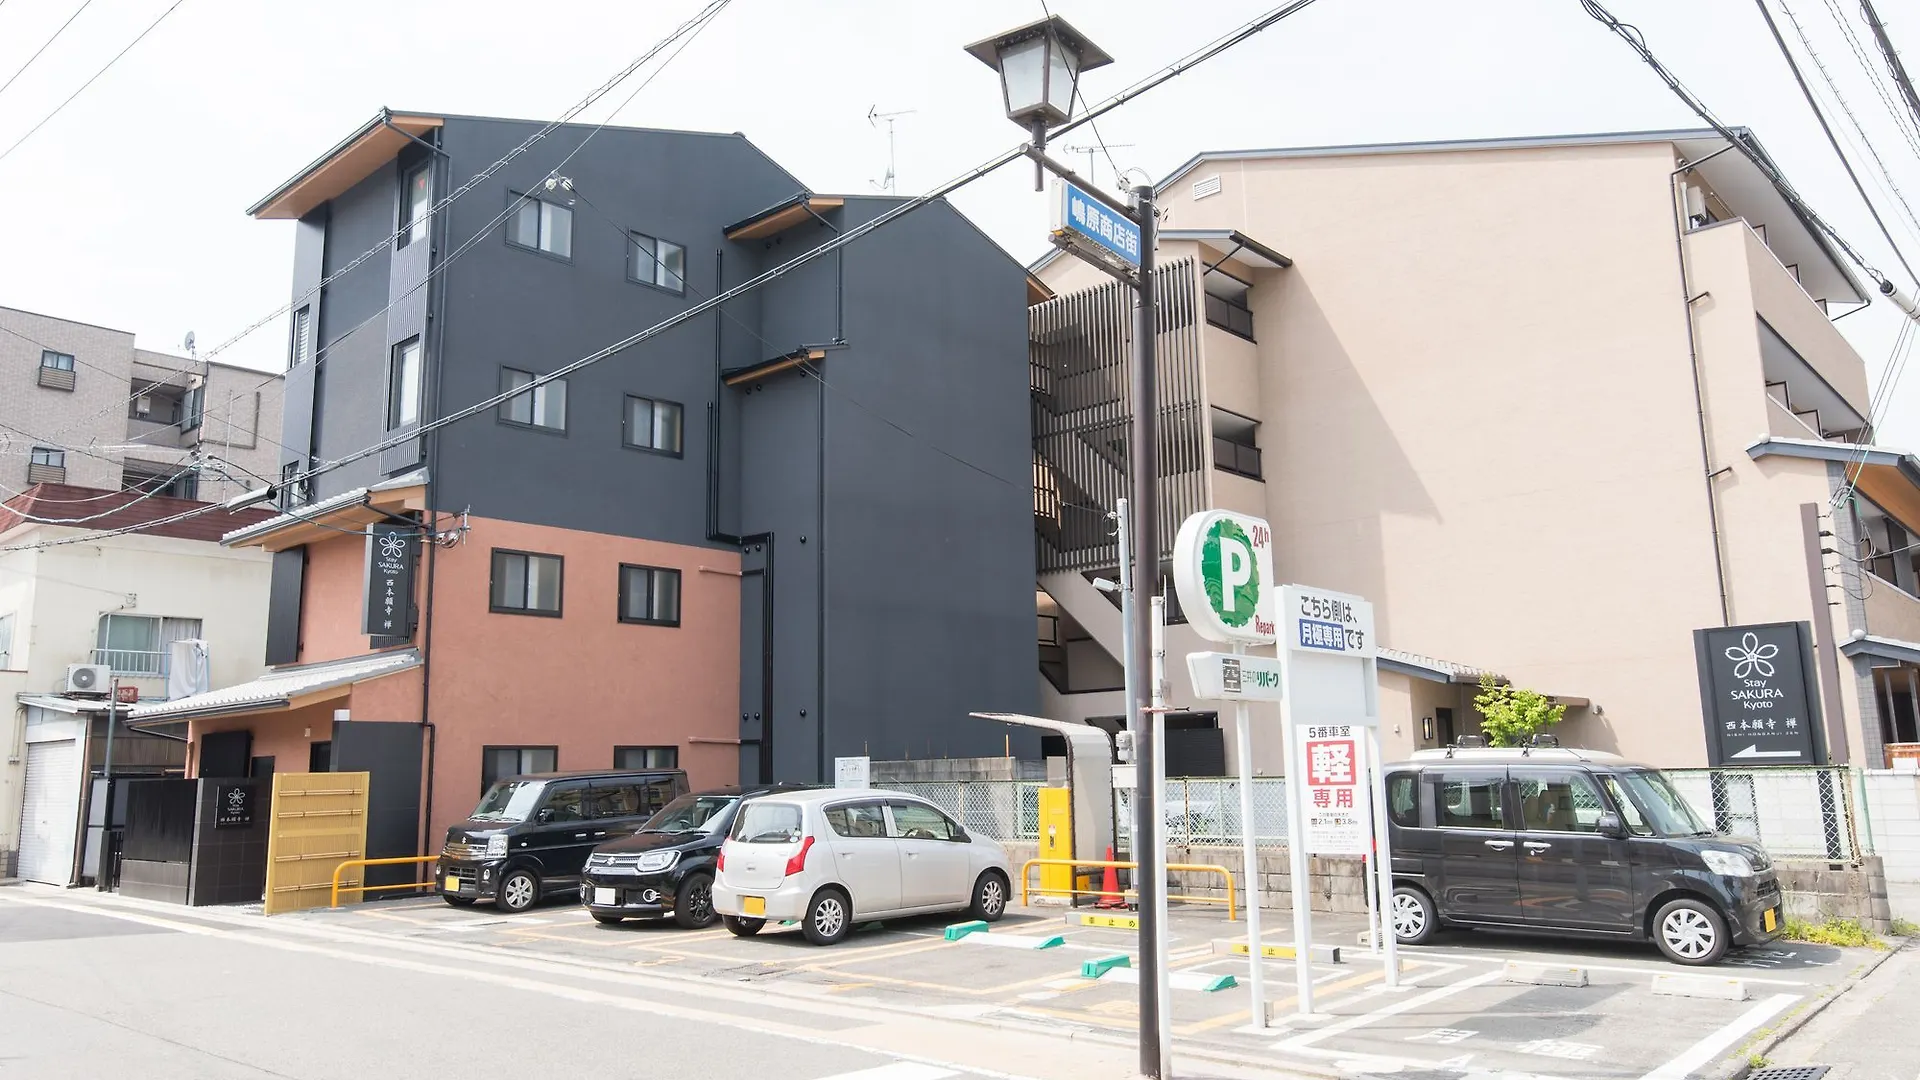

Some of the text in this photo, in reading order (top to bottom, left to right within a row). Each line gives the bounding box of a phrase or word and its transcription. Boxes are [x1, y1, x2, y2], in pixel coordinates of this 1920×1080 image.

[1253, 525, 1270, 548] 24h
[378, 562, 404, 570] SAKURA
[1219, 536, 1252, 612] P
[1301, 596, 1357, 623] こちら側は、
[1255, 615, 1276, 636] Repark
[1743, 679, 1767, 688] Stay
[1730, 689, 1784, 699] SAKURA
[1743, 700, 1773, 710] Kyoto
[1309, 726, 1350, 738] 5番車室
[1726, 718, 1777, 730] 西本願寺
[1312, 744, 1350, 784] 軽
[1313, 789, 1353, 809] 専用
